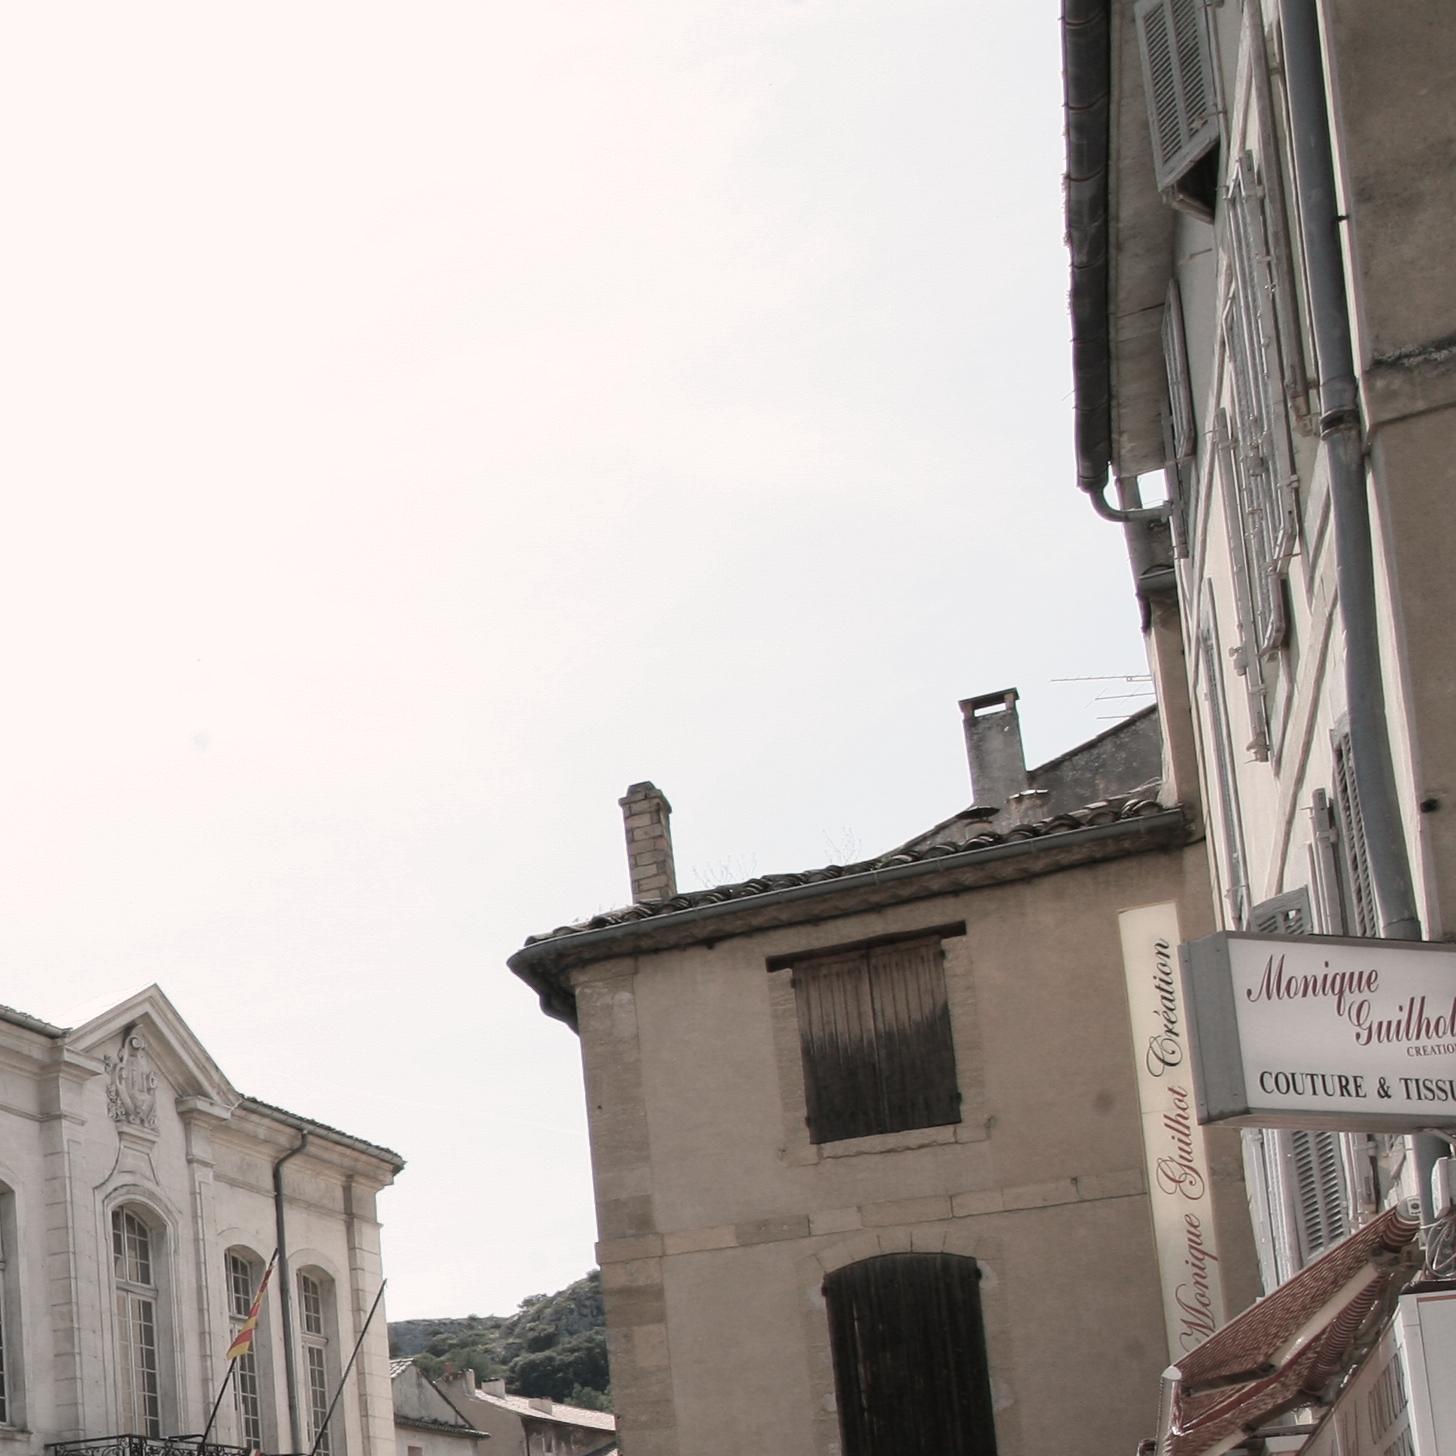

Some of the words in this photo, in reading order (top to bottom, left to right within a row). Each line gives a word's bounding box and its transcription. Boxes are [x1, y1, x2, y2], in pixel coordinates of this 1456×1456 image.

[1146, 937, 1183, 1077] Création
[1246, 953, 1379, 1017] Monique
[1259, 1070, 1367, 1099] COUTURE
[1376, 1076, 1392, 1099] &
[1406, 1043, 1456, 1057] CREATIO
[1156, 1086, 1205, 1200] Guilhot
[1175, 1213, 1218, 1352] Monique
